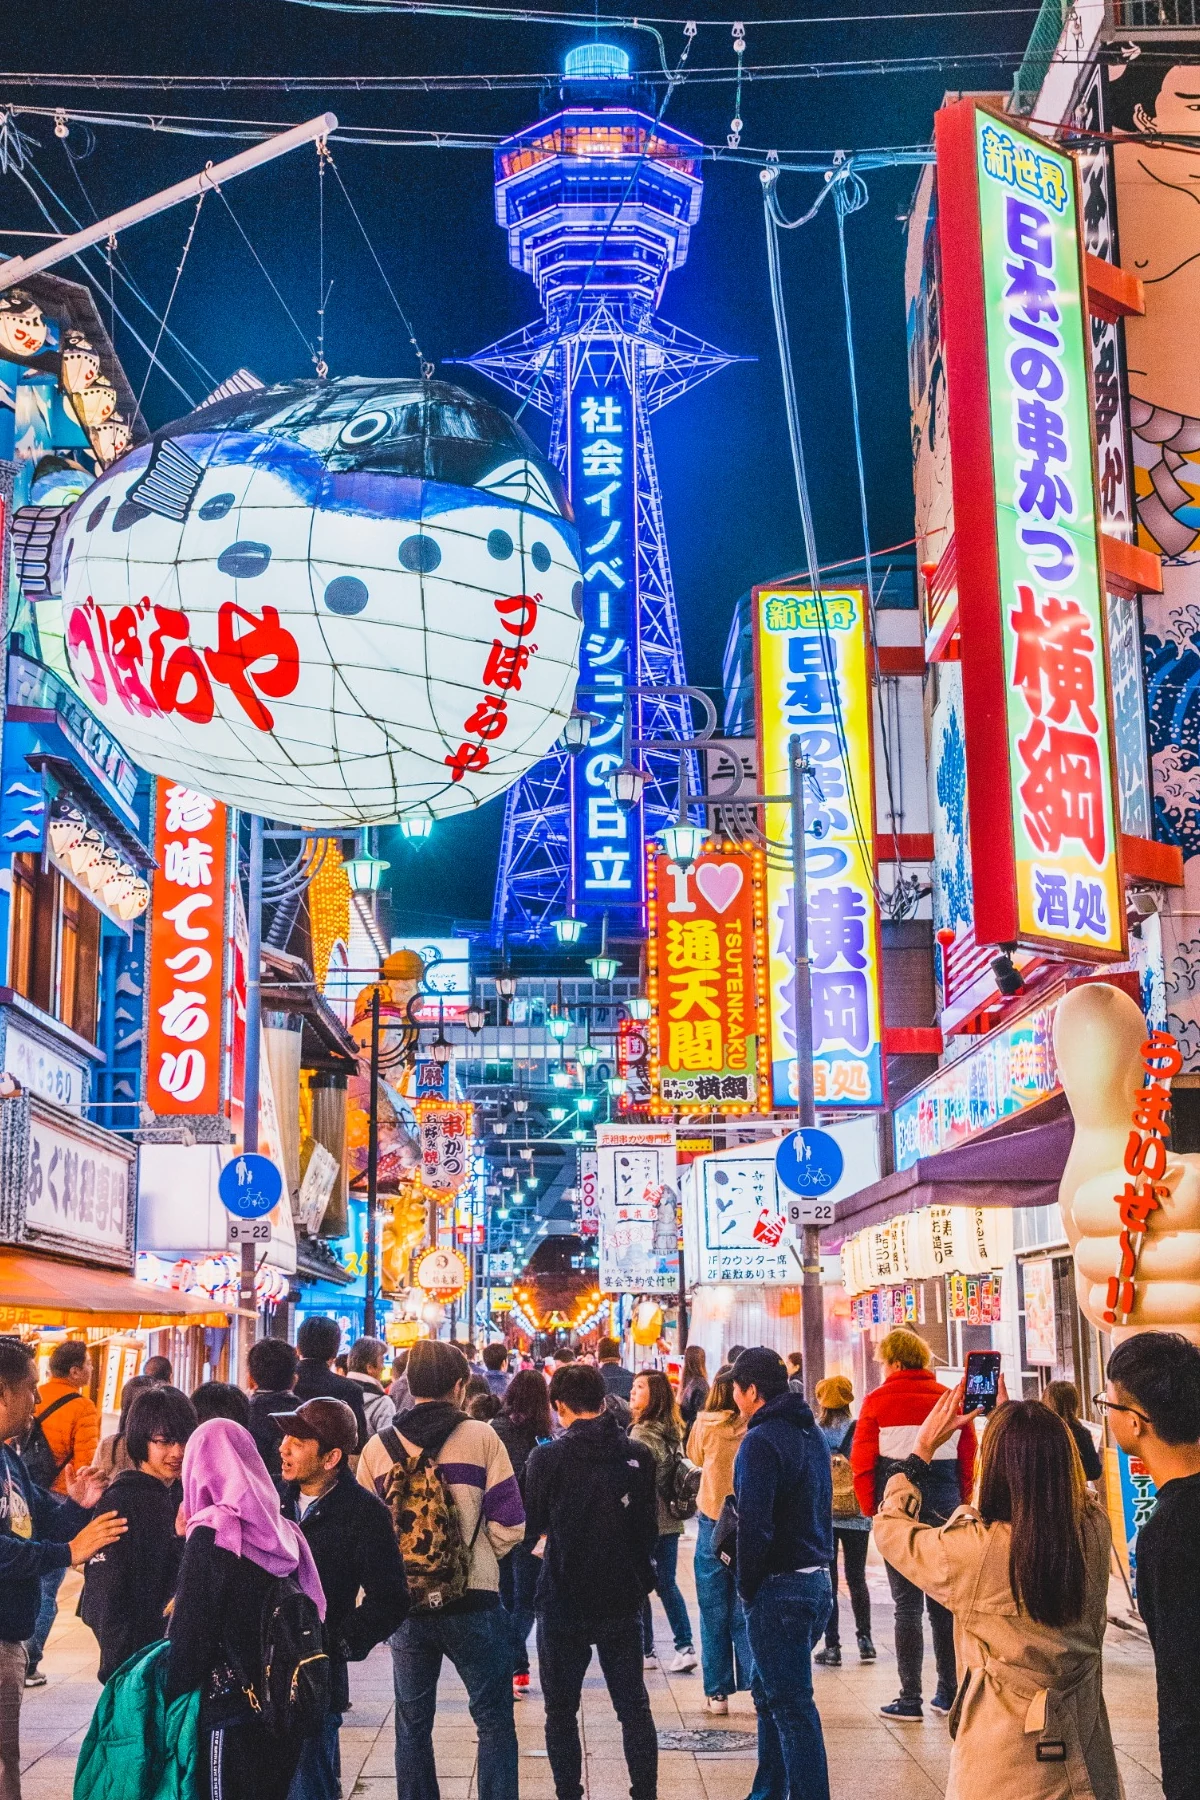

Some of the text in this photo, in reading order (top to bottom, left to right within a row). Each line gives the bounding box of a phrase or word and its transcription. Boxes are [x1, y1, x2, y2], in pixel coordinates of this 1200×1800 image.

[984, 126, 1067, 211] 新世界
[766, 598, 856, 630] 新世界
[67, 595, 300, 732] づぼらや
[444, 592, 544, 782] づぼらや
[1037, 870, 1107, 936] 酒処
[666, 919, 722, 1071] 通天閣
[725, 919, 746, 1069] TSUTENKAKU
[663, 1079, 694, 1088] 日本一の
[664, 1089, 694, 1100] 串かつ
[695, 1075, 748, 1100] 横綱
[424, 1114, 439, 1175] お好み焼き
[442, 1113, 463, 1174] 串かつ
[602, 1134, 672, 1145] 元祖串カツ専門店
[604, 1275, 676, 1288] 宴会予約受付中
[721, 1255, 787, 1266] カウンター席
[721, 1269, 788, 1280] 座敷あります
